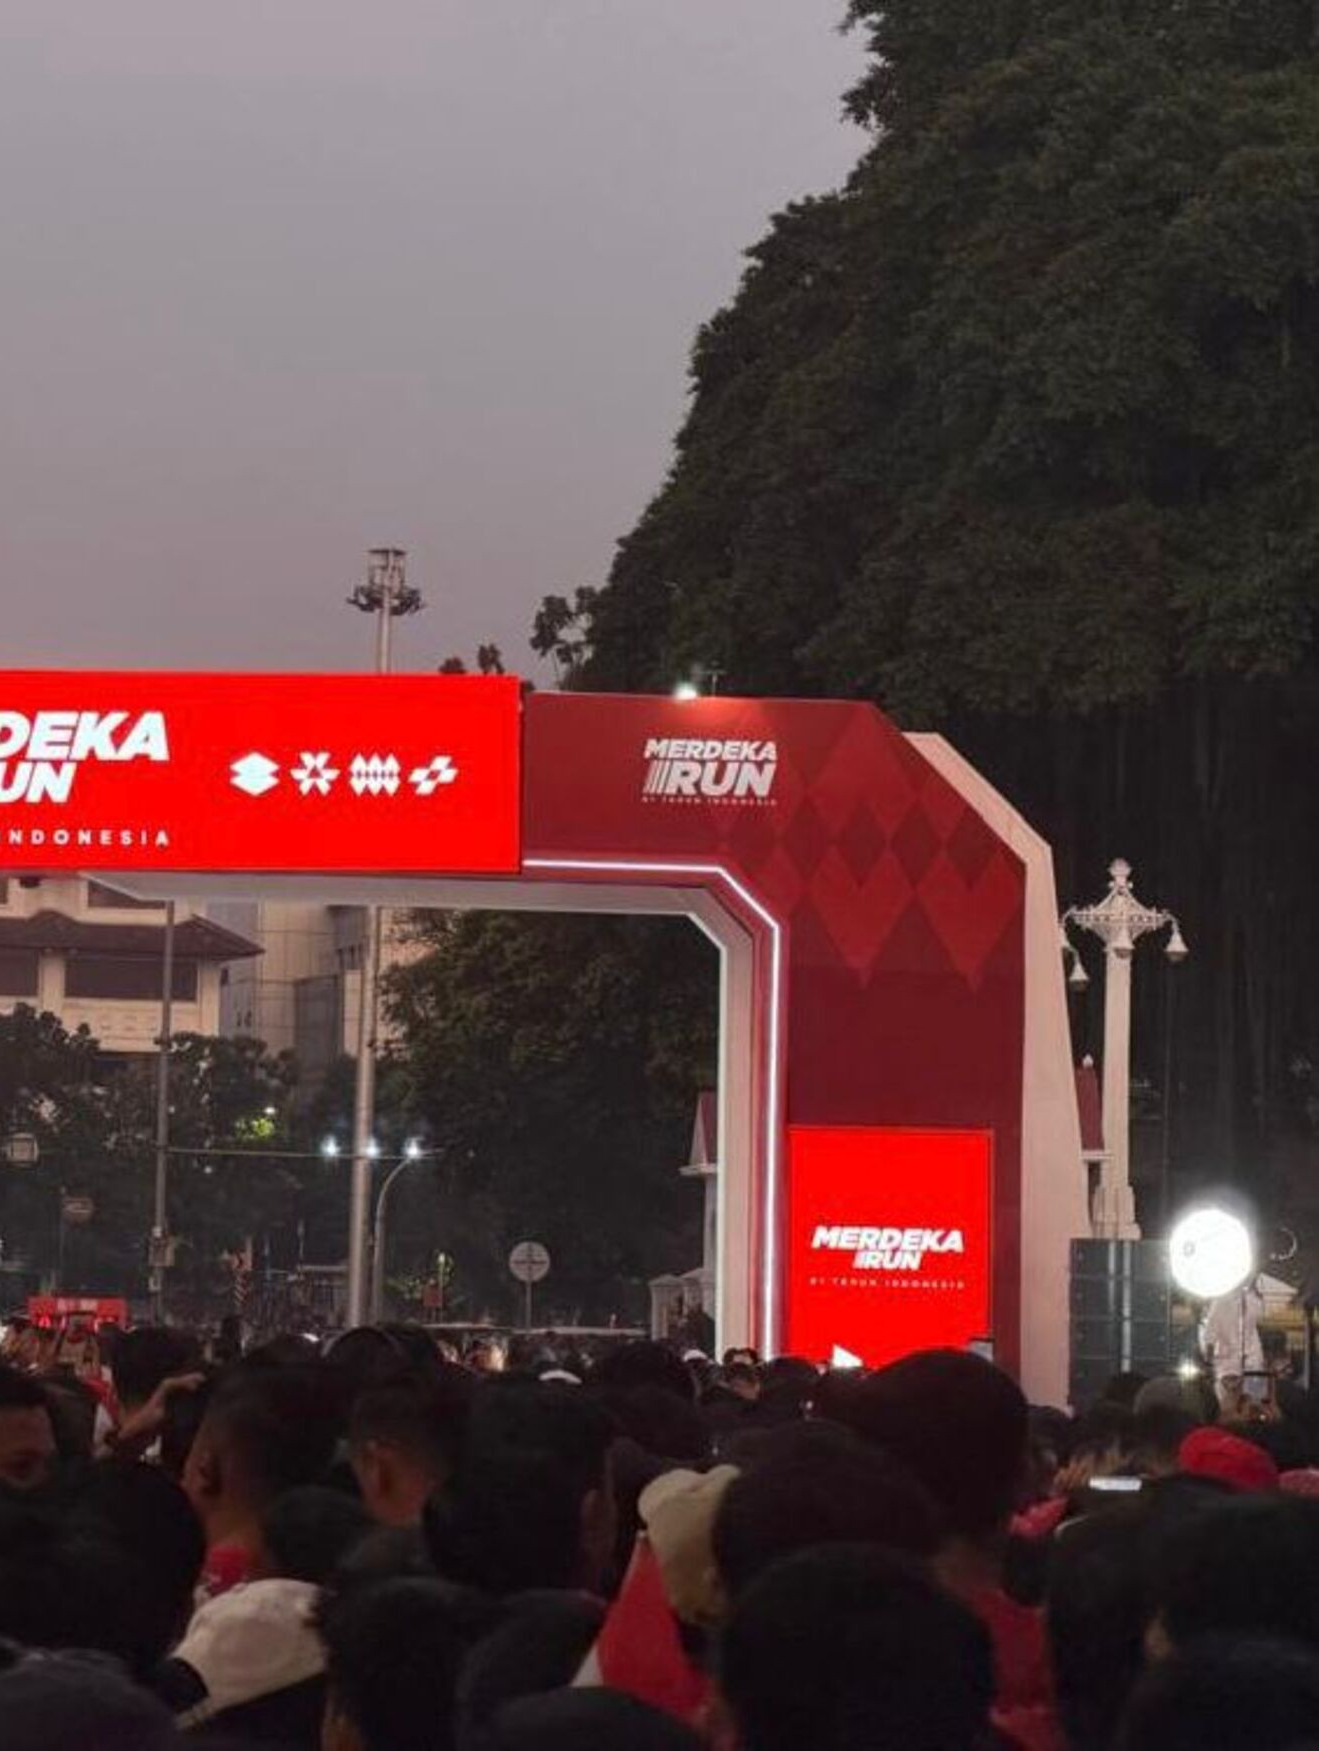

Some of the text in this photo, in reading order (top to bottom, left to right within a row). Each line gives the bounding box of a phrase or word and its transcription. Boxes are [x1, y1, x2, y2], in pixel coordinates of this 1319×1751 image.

[644, 738, 777, 761] MERDEKA
[643, 760, 777, 797] RUN
[811, 1225, 964, 1253] MERDEKA
[852, 1250, 922, 1271] RUN
